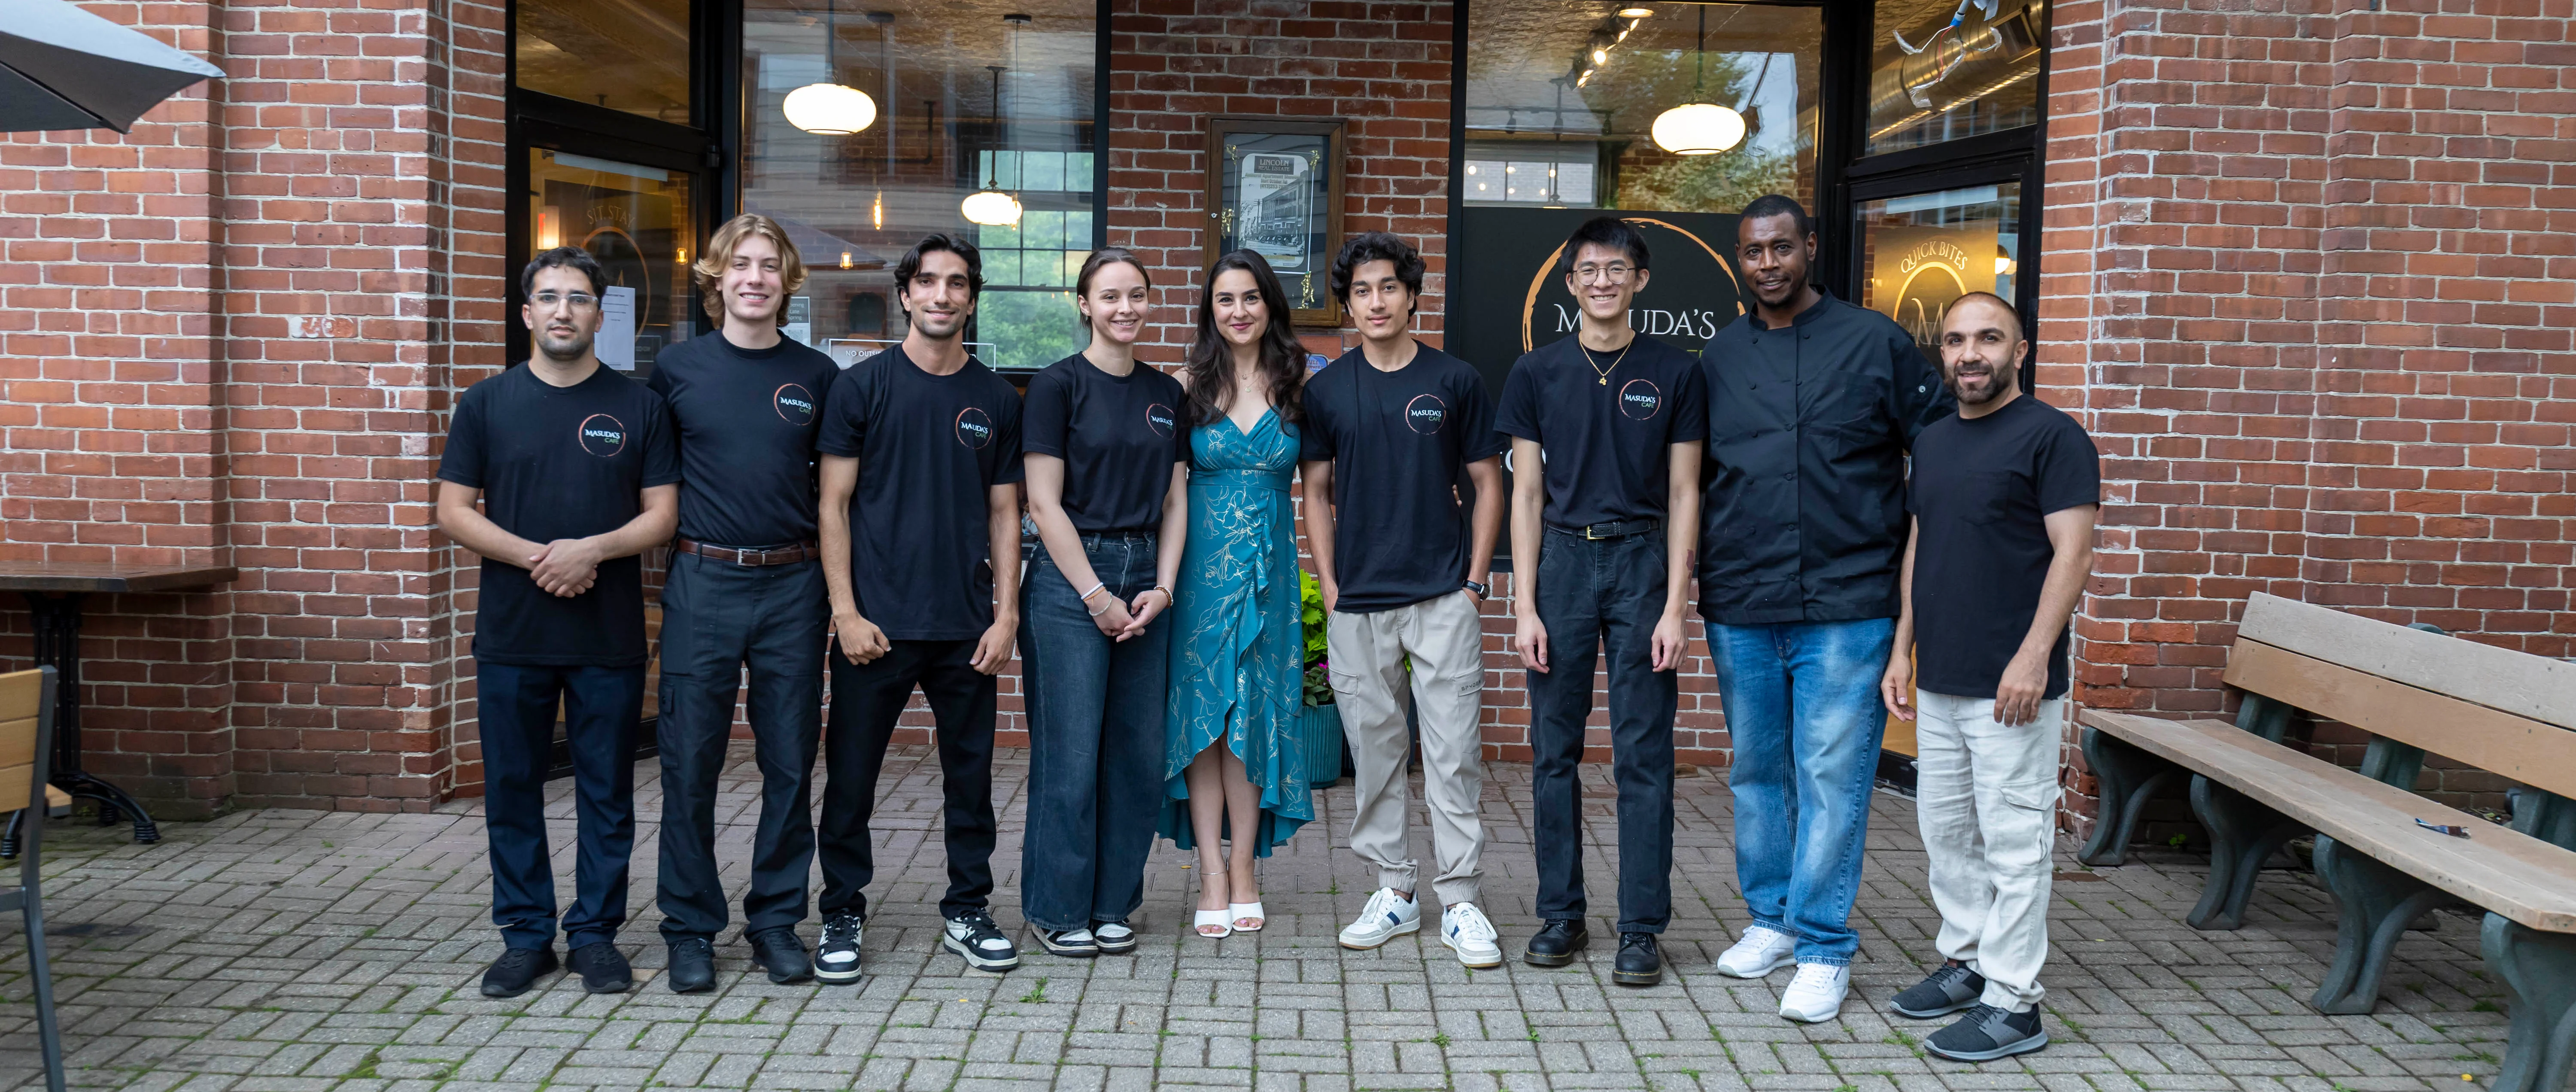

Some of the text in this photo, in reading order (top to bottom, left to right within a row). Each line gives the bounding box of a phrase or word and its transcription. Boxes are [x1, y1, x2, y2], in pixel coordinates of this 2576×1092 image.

[608, 205, 635, 228] STAY
[1901, 241, 1968, 273] QUICK BITES
[1554, 304, 1716, 339] MUDA'S
[780, 396, 812, 410] MASUDA'S
[1625, 394, 1656, 404] MASUDA'S
[584, 429, 620, 439] MASUDA'S
[961, 421, 988, 434] MAUDA'S
